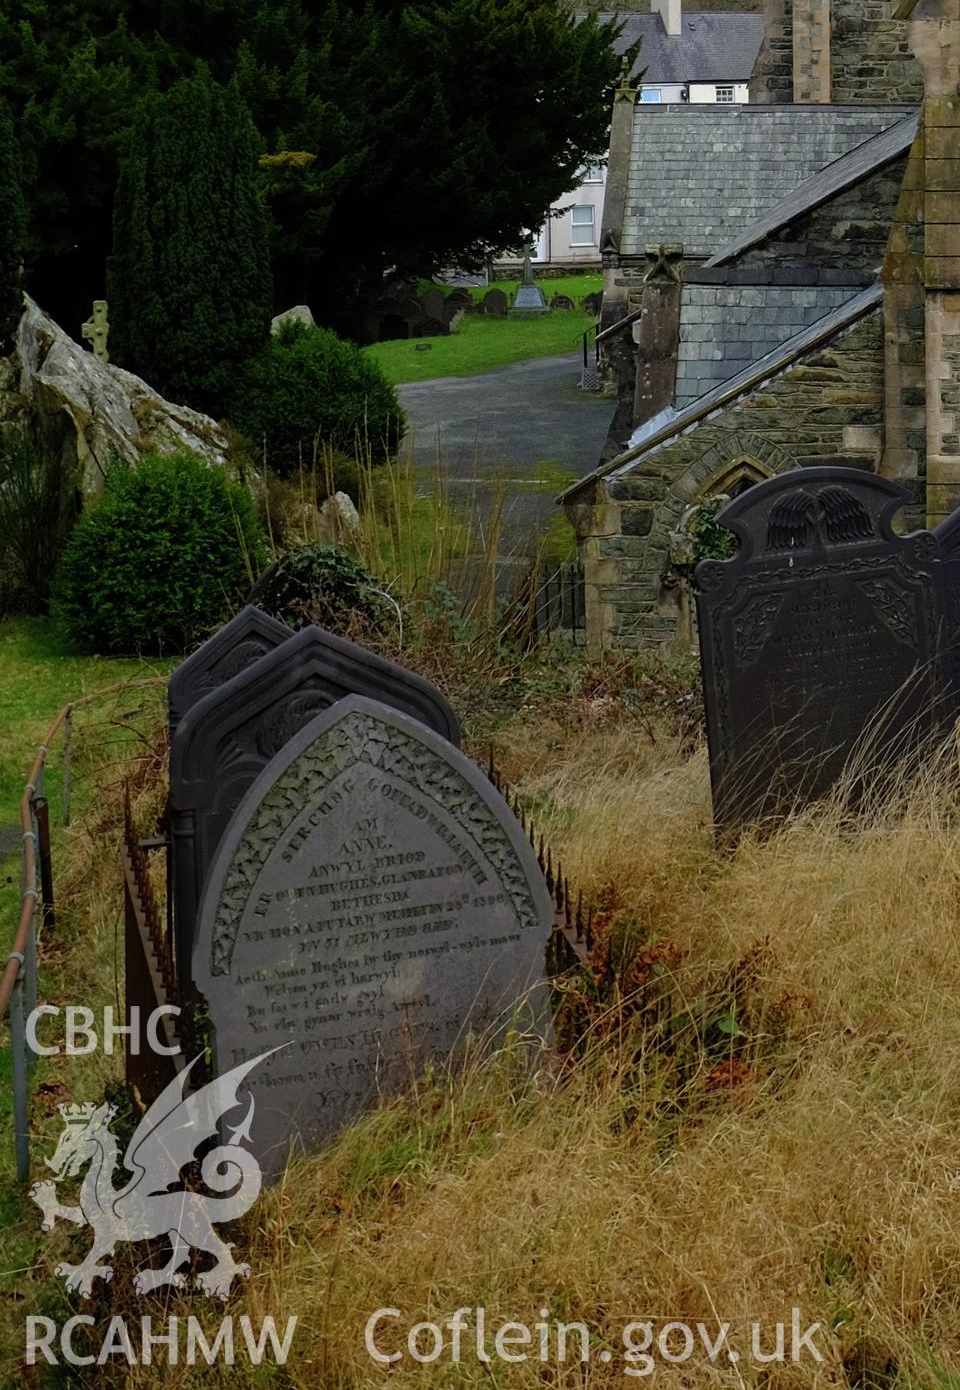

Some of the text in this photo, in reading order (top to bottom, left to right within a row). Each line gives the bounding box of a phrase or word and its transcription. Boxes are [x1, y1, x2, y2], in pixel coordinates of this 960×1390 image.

[281, 778, 355, 863] SERCHOG
[353, 817, 378, 834] AM
[308, 851, 426, 879] ANWYL BRIOD
[330, 889, 409, 911] BETHESDA
[311, 957, 360, 976] Hughes
